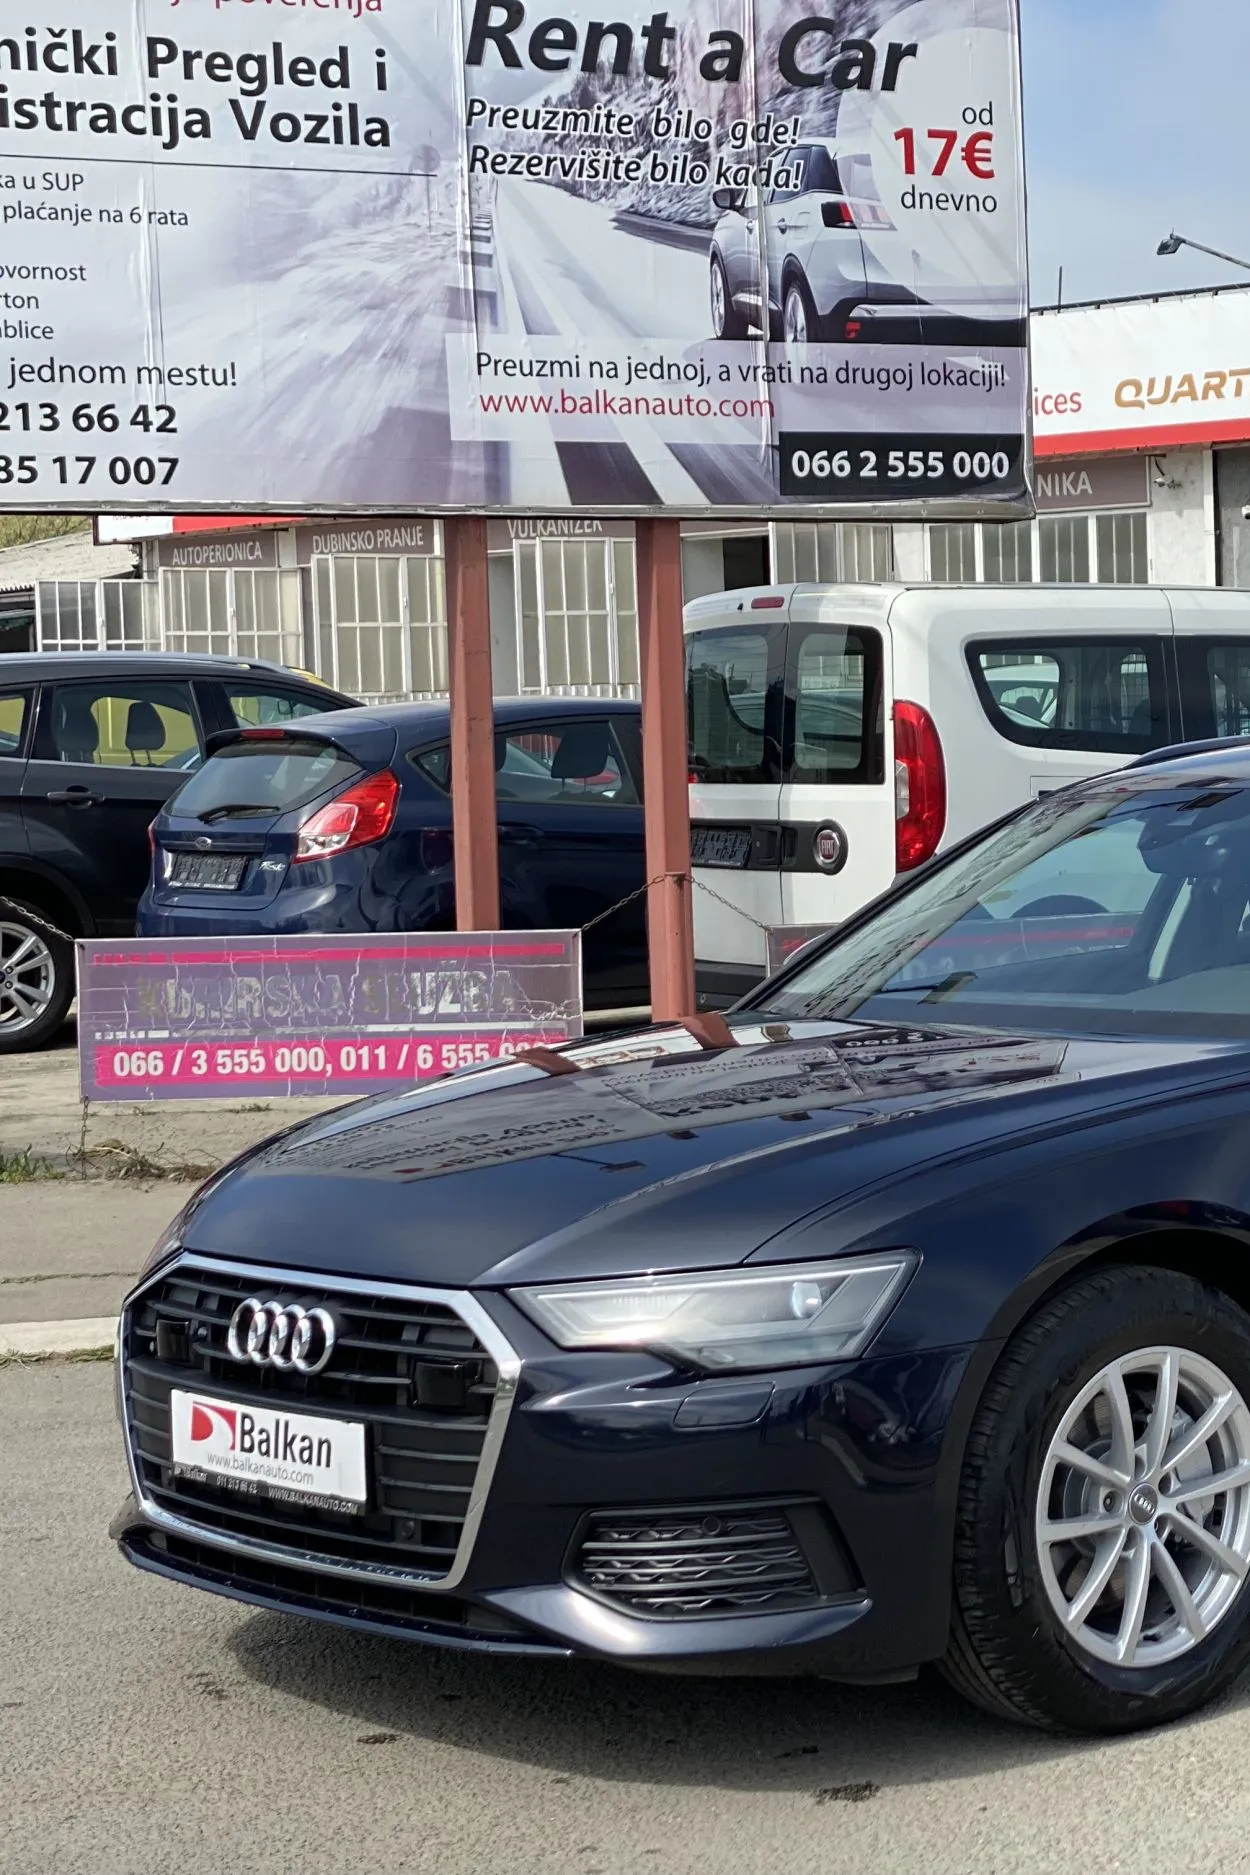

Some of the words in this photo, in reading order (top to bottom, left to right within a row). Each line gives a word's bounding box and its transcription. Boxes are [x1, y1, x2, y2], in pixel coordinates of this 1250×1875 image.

[465, 0, 676, 82] Rent
[700, 30, 744, 83] a
[779, 17, 918, 92] Car
[147, 36, 350, 96] Pregled
[376, 49, 387, 91] i
[0, 84, 211, 150] istracija
[229, 99, 391, 147] Vozila
[466, 99, 633, 137] Preuzmite
[653, 106, 713, 142] bilo
[730, 112, 800, 149] gde!
[961, 102, 994, 127] od
[469, 145, 640, 183] Rezervišite
[649, 151, 708, 186] bilo
[715, 157, 803, 191] kada!
[894, 127, 995, 179] 17€
[23, 176, 35, 190] u
[42, 172, 84, 191] SUP
[3, 200, 92, 226] plaćanje
[100, 209, 124, 223] na
[130, 207, 142, 223] 6
[149, 210, 189, 226] rata
[900, 184, 998, 214] dnevno
[0, 319, 54, 339] blice
[7, 357, 126, 389] jednom
[137, 362, 237, 387] mestu!
[477, 352, 581, 380] Preuzmi
[589, 361, 619, 380] na
[625, 355, 714, 386] jednoj,
[718, 366, 731, 382] a
[738, 361, 793, 385] vrati
[800, 366, 829, 386] na
[835, 362, 913, 390] drugoj
[920, 362, 1006, 389] lokaciji!
[480, 390, 775, 419] www.balkanauto.com
[1034, 387, 1083, 416] ices
[72, 403, 120, 433] 66
[130, 404, 178, 433] 42
[52, 456, 96, 484] 17
[109, 456, 179, 485] 007
[791, 450, 852, 478] 066
[859, 450, 880, 478] 2
[886, 451, 945, 479] 555
[953, 451, 1010, 480] 000
[1036, 470, 1093, 497] NIKA
[172, 541, 263, 566] AUTOPERIONICA
[313, 529, 375, 554] DUBINSKO
[377, 525, 424, 549] PRANJE
[113, 1051, 164, 1077] 066
[191, 1049, 207, 1075] 3
[216, 1048, 266, 1074] 555
[275, 1045, 333, 1077] 000,
[340, 1044, 387, 1071] 011
[417, 1043, 434, 1069] 6
[441, 1042, 490, 1069] 555
[240, 1411, 332, 1468] Balkan
[207, 1452, 314, 1486] www.balkanauto.com
